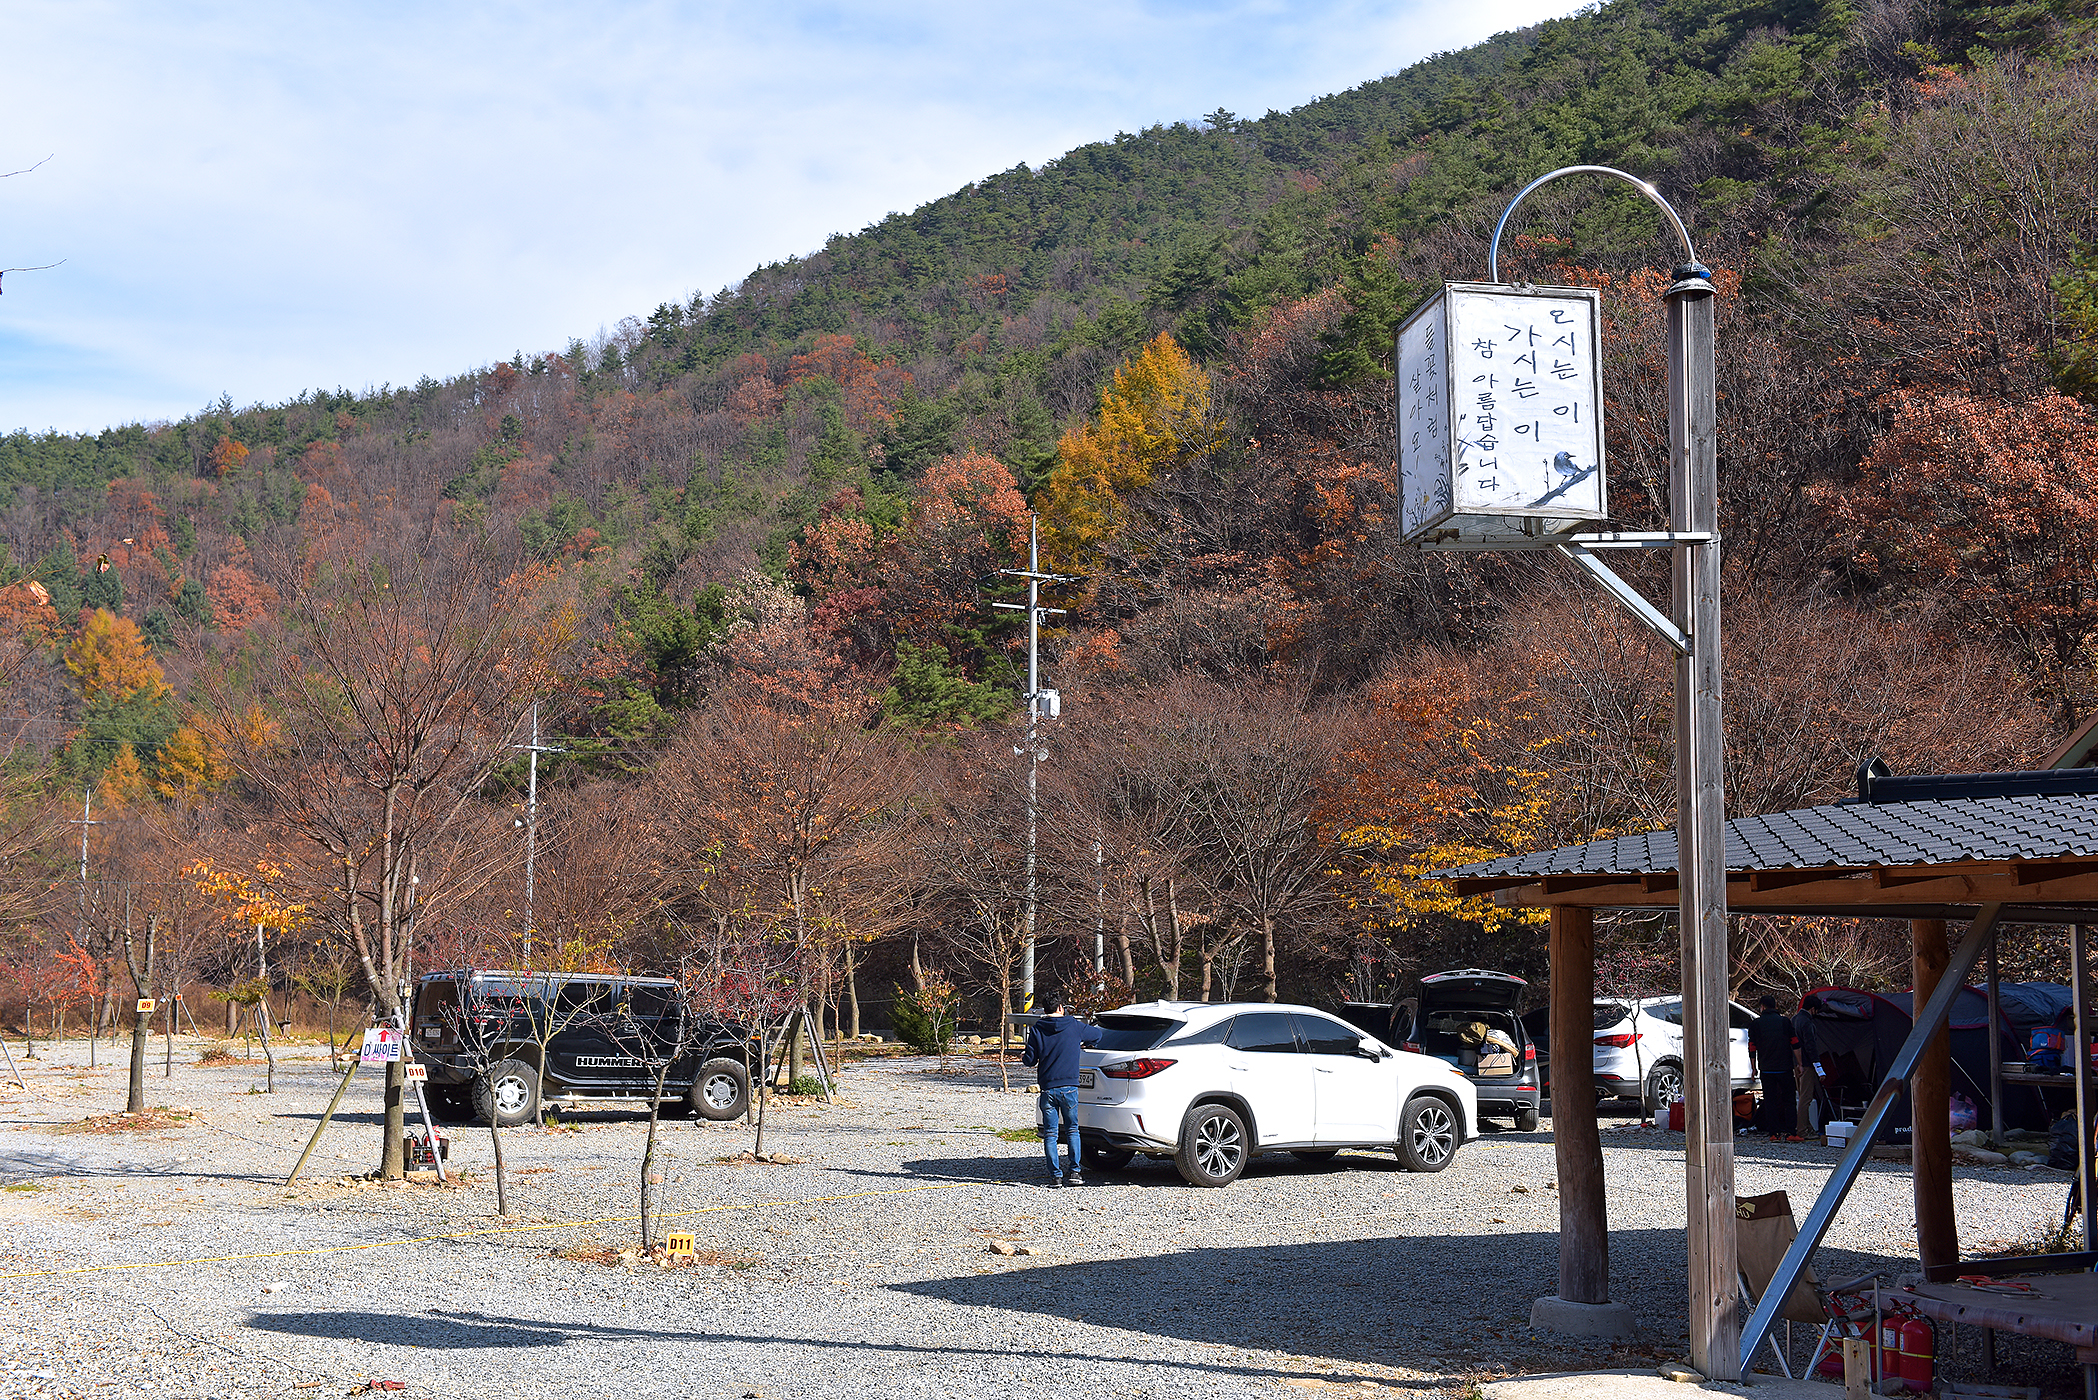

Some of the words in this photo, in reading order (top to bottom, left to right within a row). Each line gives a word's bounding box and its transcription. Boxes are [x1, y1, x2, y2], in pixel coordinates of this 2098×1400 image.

[1471, 338, 1497, 359] 참
[1550, 309, 1579, 380] 오시는
[1503, 325, 1542, 398] 가시는
[1424, 322, 1439, 438] 들꽃처럼
[1553, 402, 1579, 423] 이
[1472, 373, 1500, 491] 아름답습니다
[1514, 421, 1540, 442] 이
[364, 1043, 371, 1057] D
[372, 1043, 399, 1058] 싸이트
[408, 1067, 425, 1077] D10
[576, 1056, 641, 1067] HUMMER
[670, 1238, 691, 1250] D11
